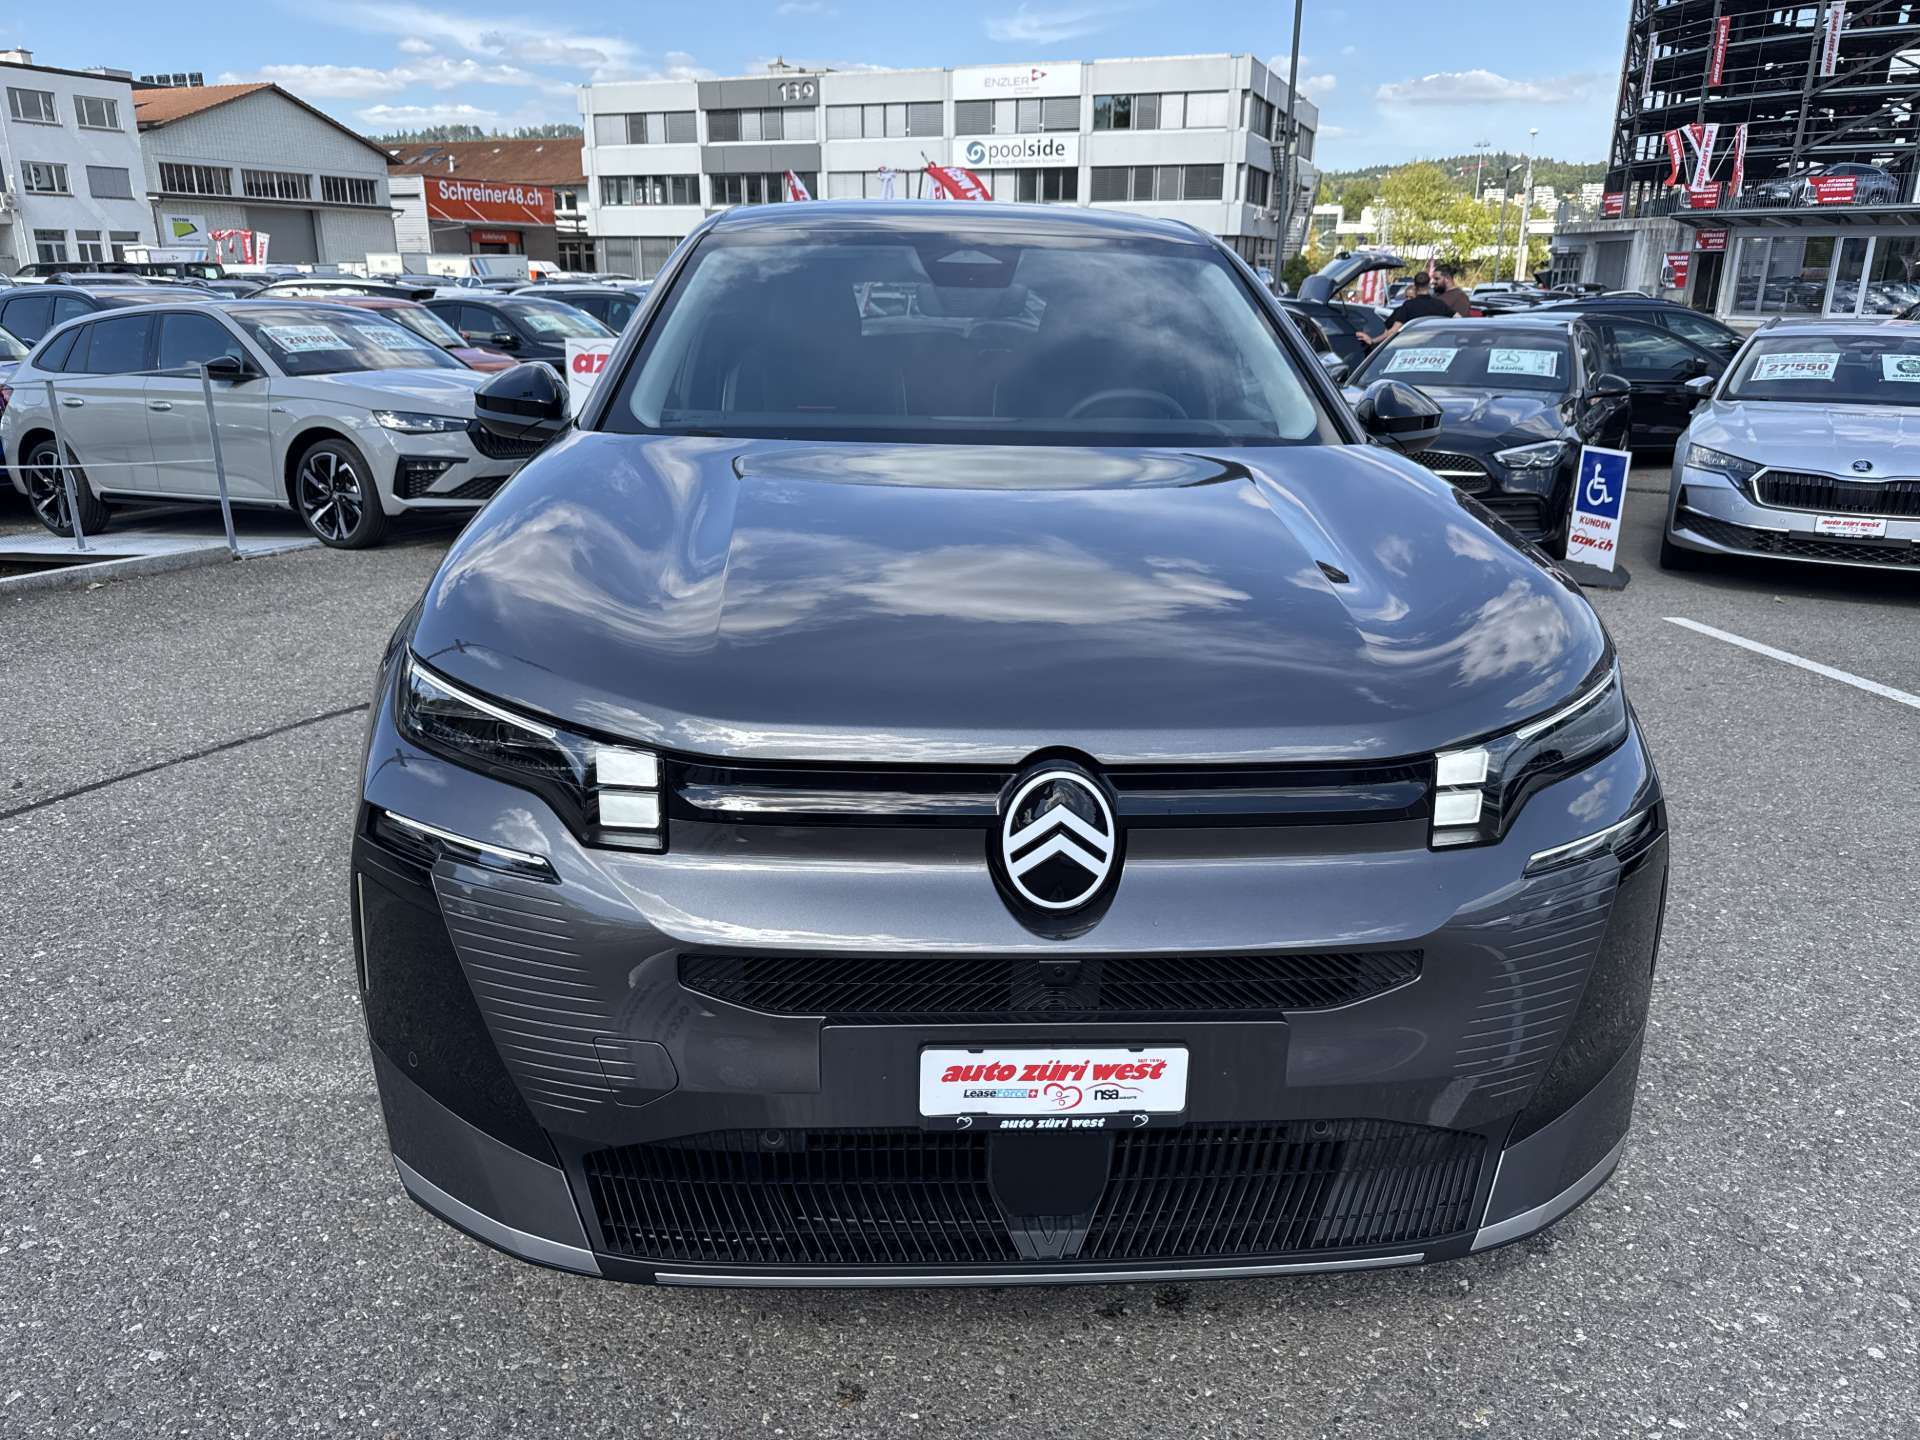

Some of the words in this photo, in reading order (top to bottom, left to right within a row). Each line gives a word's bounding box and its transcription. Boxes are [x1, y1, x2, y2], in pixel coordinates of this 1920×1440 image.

[984, 76, 1029, 88] ENZLER
[778, 81, 815, 101] 139
[988, 138, 1065, 165] poolside
[438, 180, 544, 206] Schreiner48.ch
[1768, 363, 1829, 372] 27'550
[1579, 515, 1612, 529] KUNDEN
[1571, 534, 1614, 552] azw.ch
[941, 1061, 1017, 1083] auto
[1017, 1059, 1091, 1082] züri
[1092, 1059, 1167, 1081] west
[963, 1088, 1028, 1099] LeaseForce
[1094, 1087, 1119, 1100] nsa
[1000, 1118, 1034, 1129] auto
[1035, 1117, 1067, 1129] züri
[1071, 1117, 1106, 1128] west
